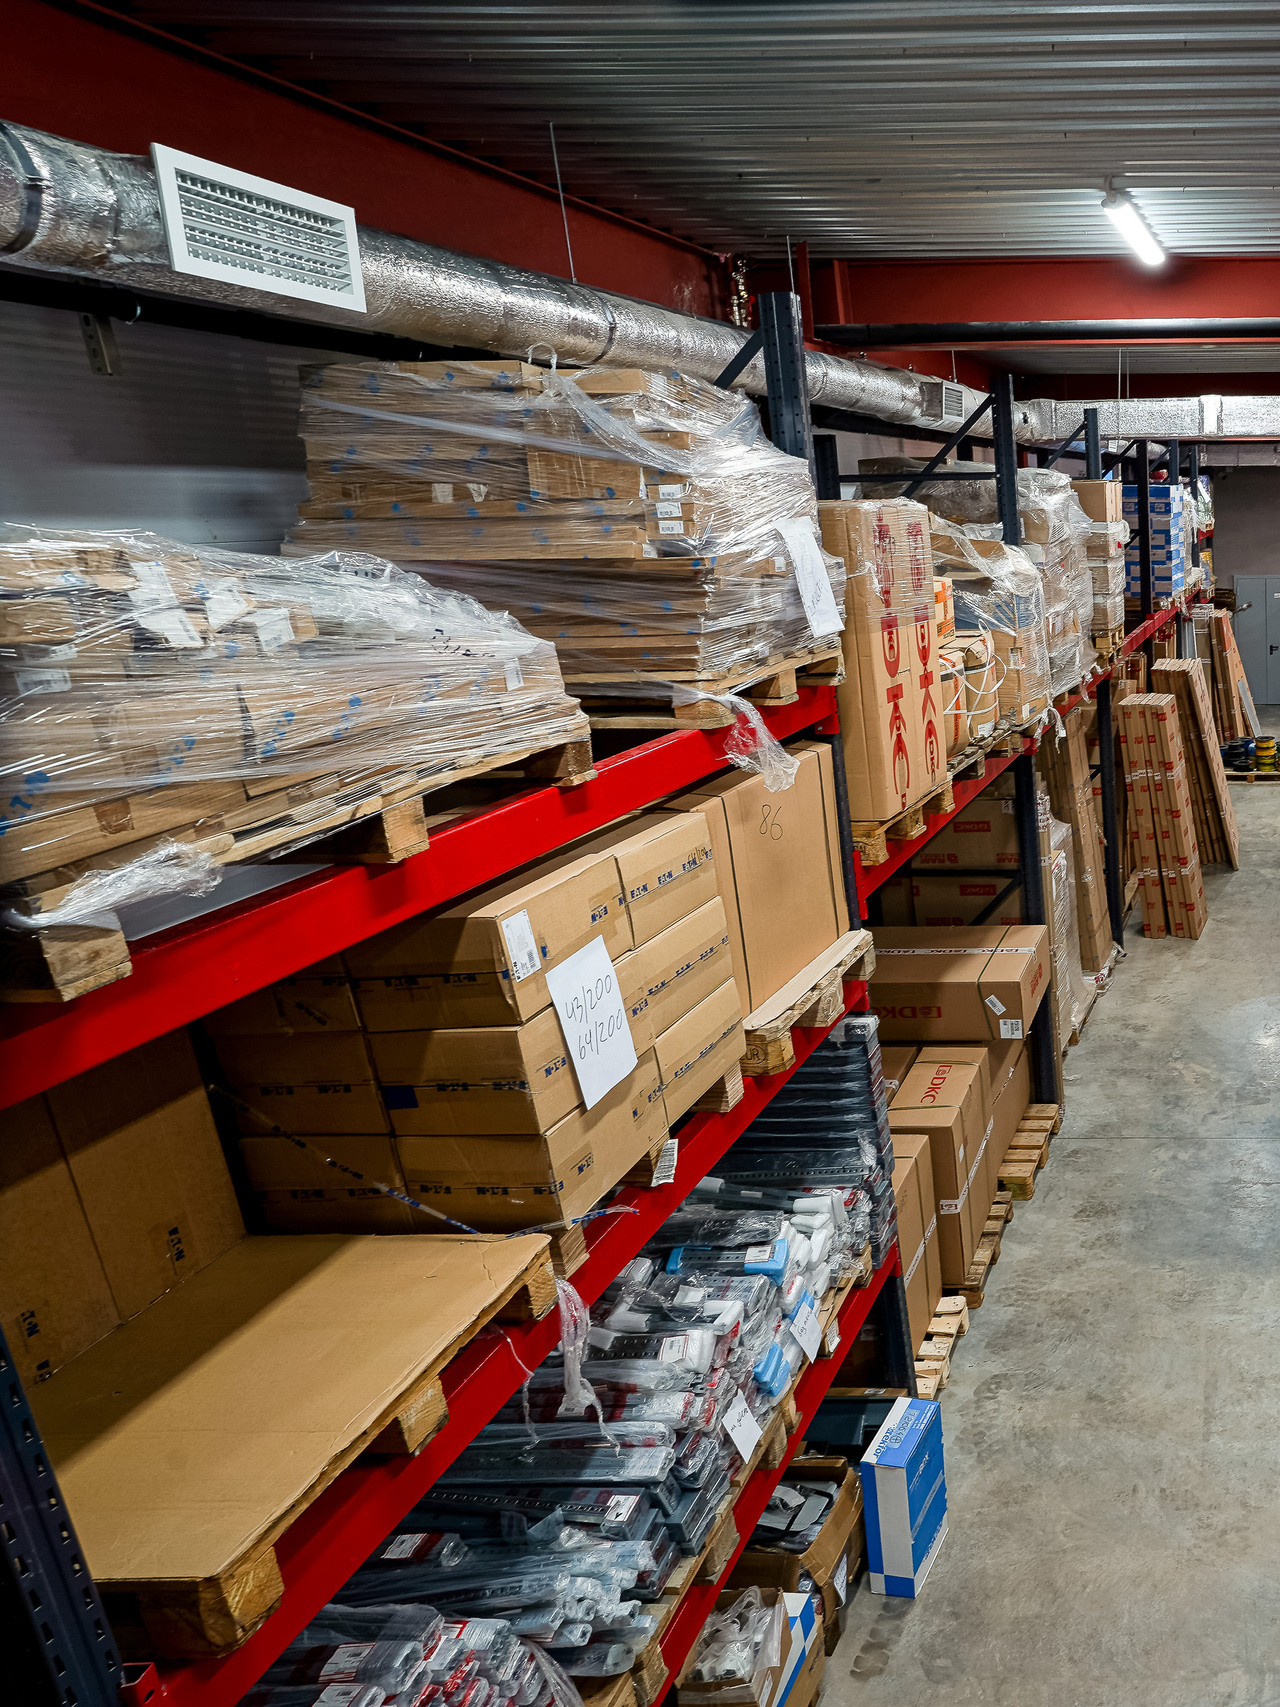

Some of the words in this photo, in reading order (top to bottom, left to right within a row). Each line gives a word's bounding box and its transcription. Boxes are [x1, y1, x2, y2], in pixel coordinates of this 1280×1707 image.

[759, 804, 783, 840] 86
[565, 974, 612, 1024] 43/200
[578, 1008, 623, 1061] 64/200
[920, 1077, 946, 1104] DKC
[873, 1427, 895, 1458] tekfor
